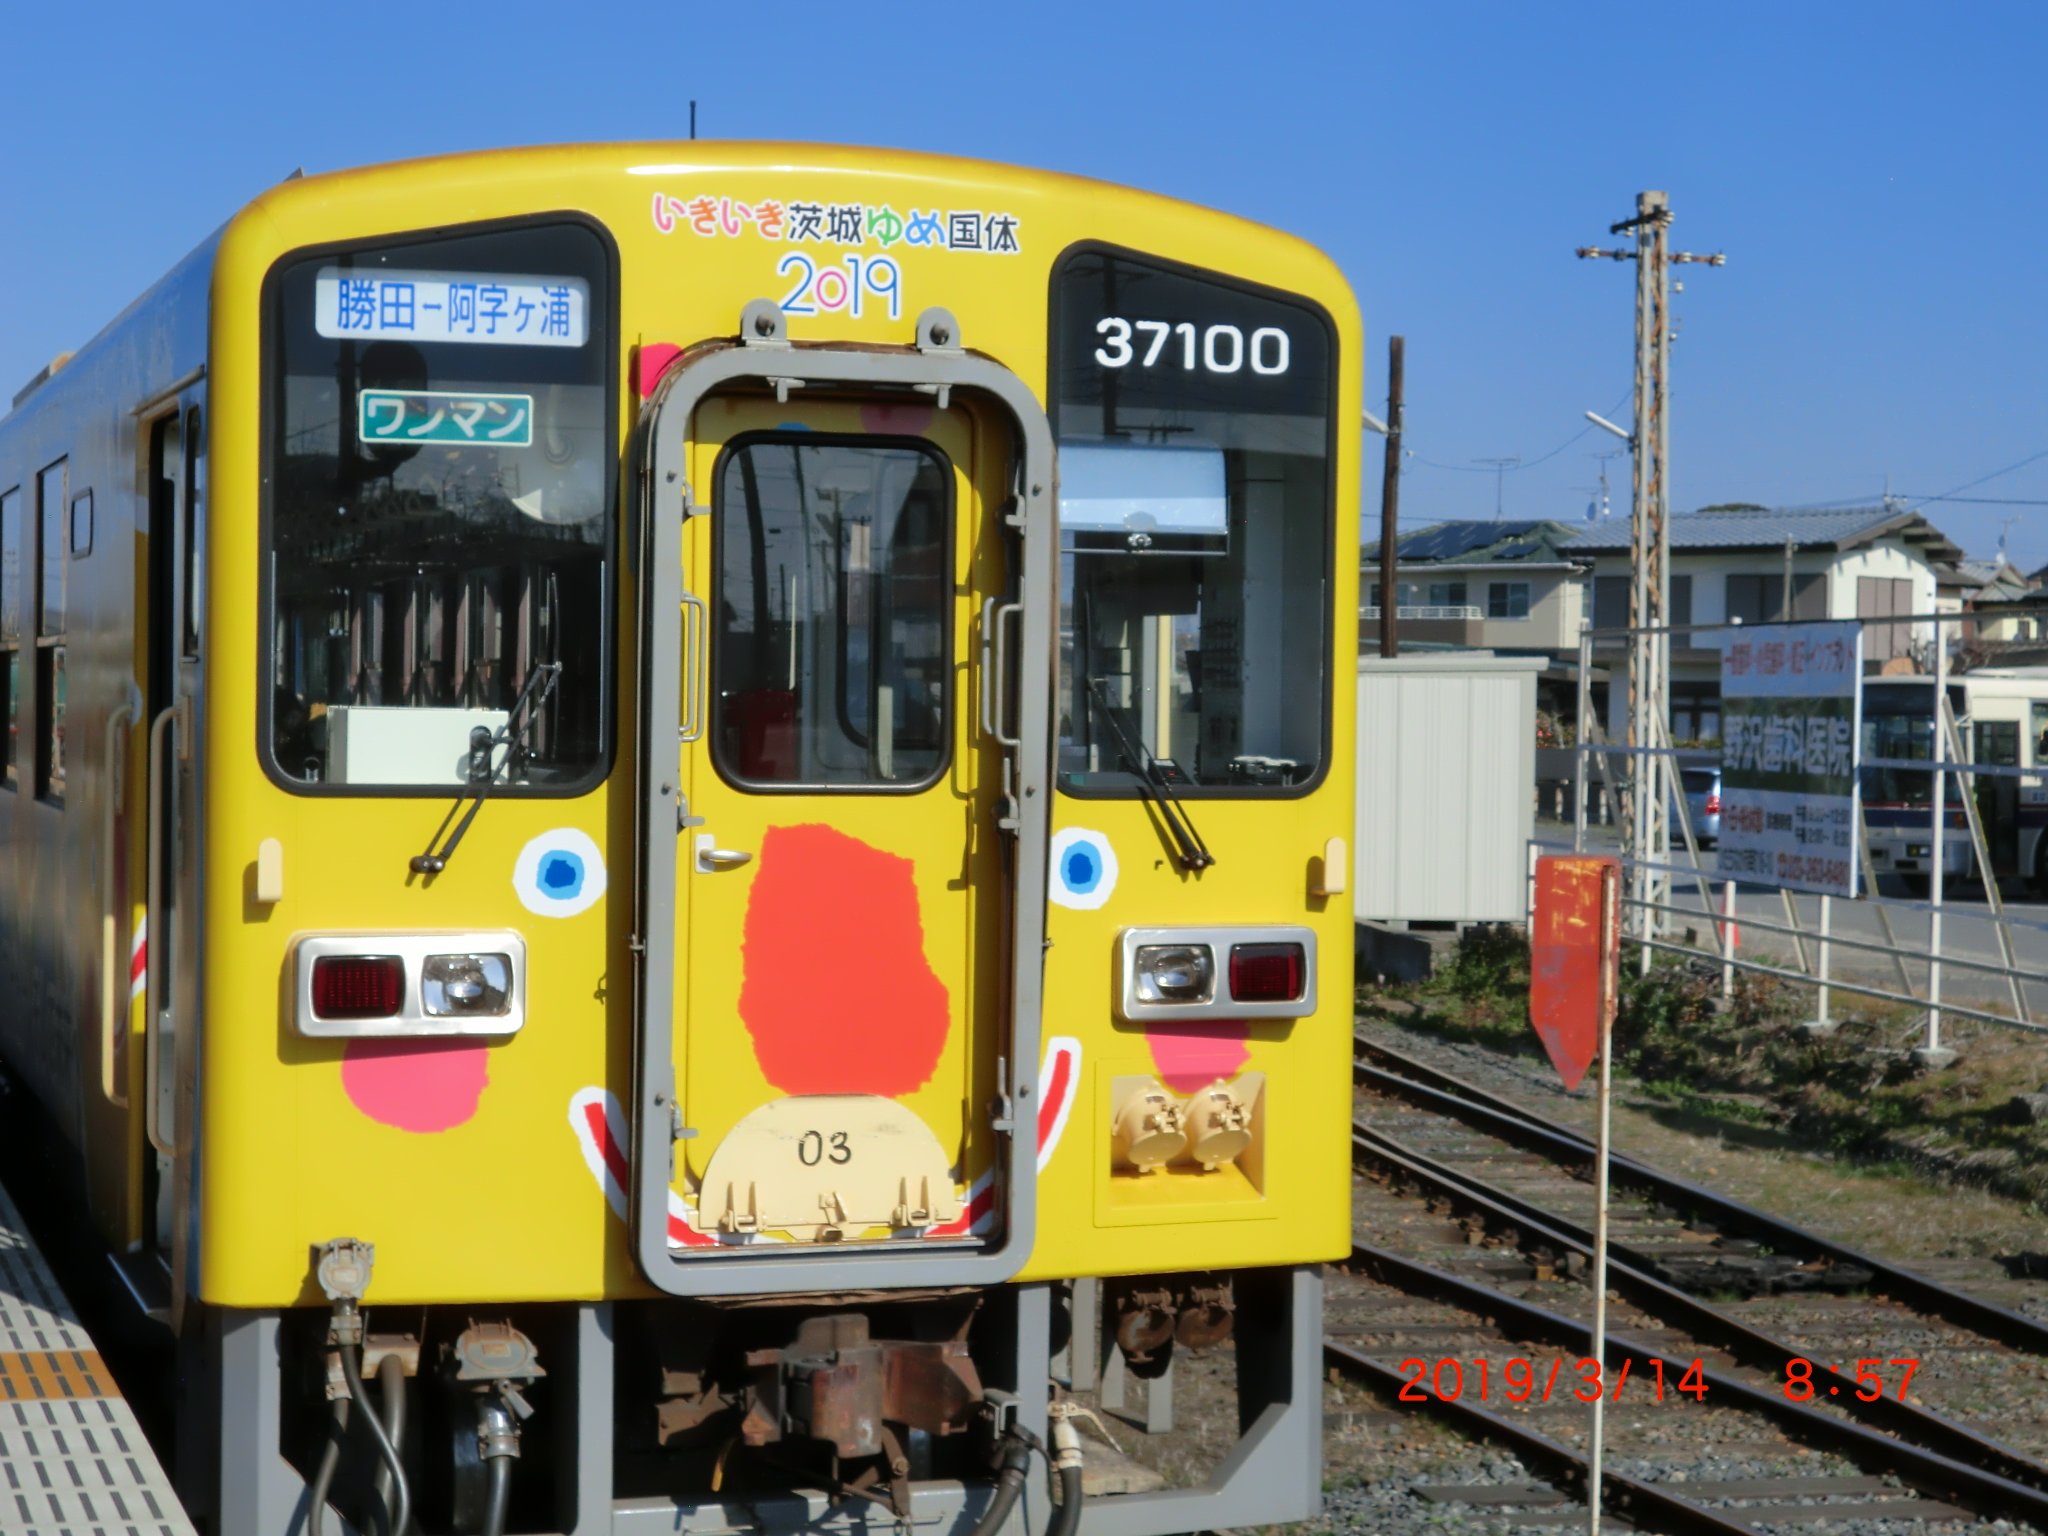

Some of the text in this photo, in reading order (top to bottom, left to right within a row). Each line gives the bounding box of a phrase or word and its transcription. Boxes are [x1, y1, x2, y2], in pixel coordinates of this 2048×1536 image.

[653, 195, 1019, 252] いきいき茨城ゆめ国体
[337, 278, 415, 332] 勝田
[779, 255, 899, 317] 2019
[1094, 316, 1290, 375] 37100
[367, 397, 525, 439] ワンマン
[1723, 714, 1850, 777] 野沢歯科医院
[798, 1130, 852, 1166] 03
